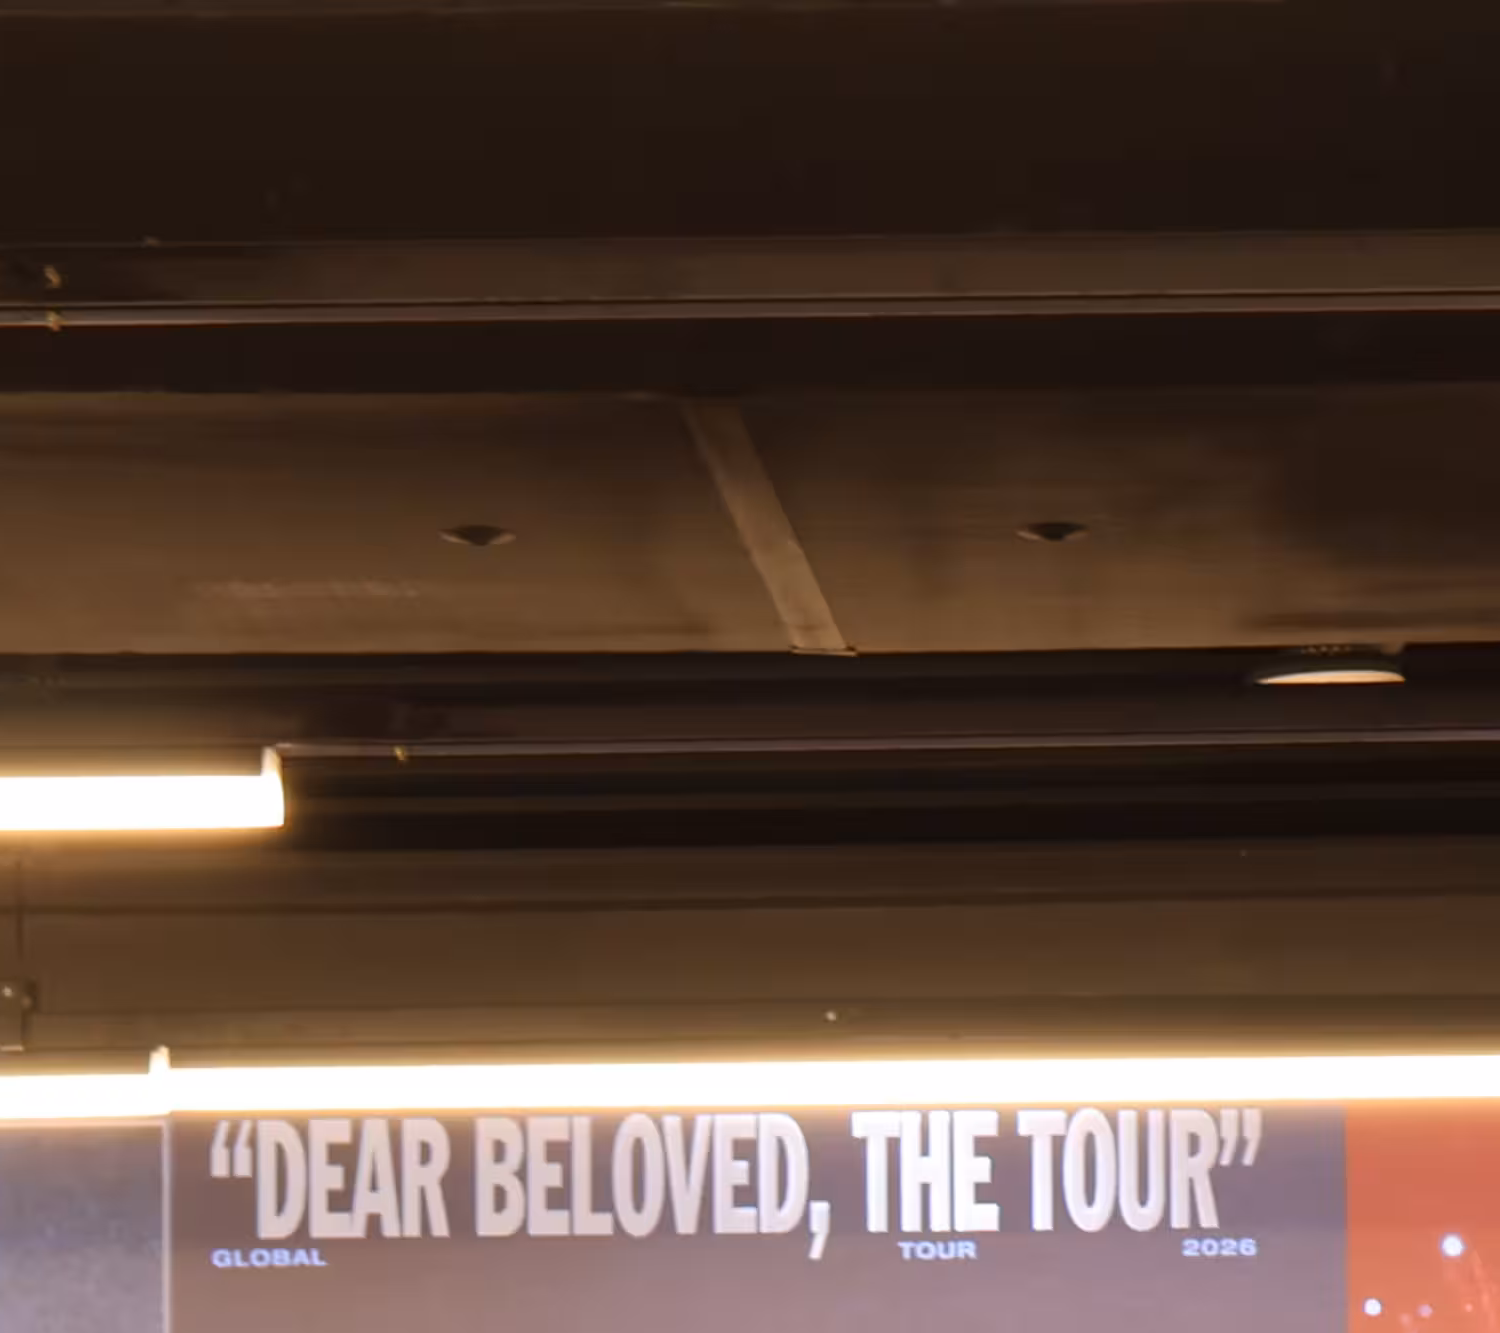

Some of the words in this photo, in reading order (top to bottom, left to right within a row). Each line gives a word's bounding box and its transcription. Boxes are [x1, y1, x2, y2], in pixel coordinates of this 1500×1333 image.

[210, 1118, 450, 1239] “DEAR
[475, 1111, 830, 1259] BELOVED,
[851, 1110, 999, 1233] THE
[1018, 1108, 1262, 1232] TOUR”
[212, 1249, 328, 1267] GLOBAL
[899, 1241, 977, 1259] TOUR
[1183, 1239, 1257, 1257] 2026
